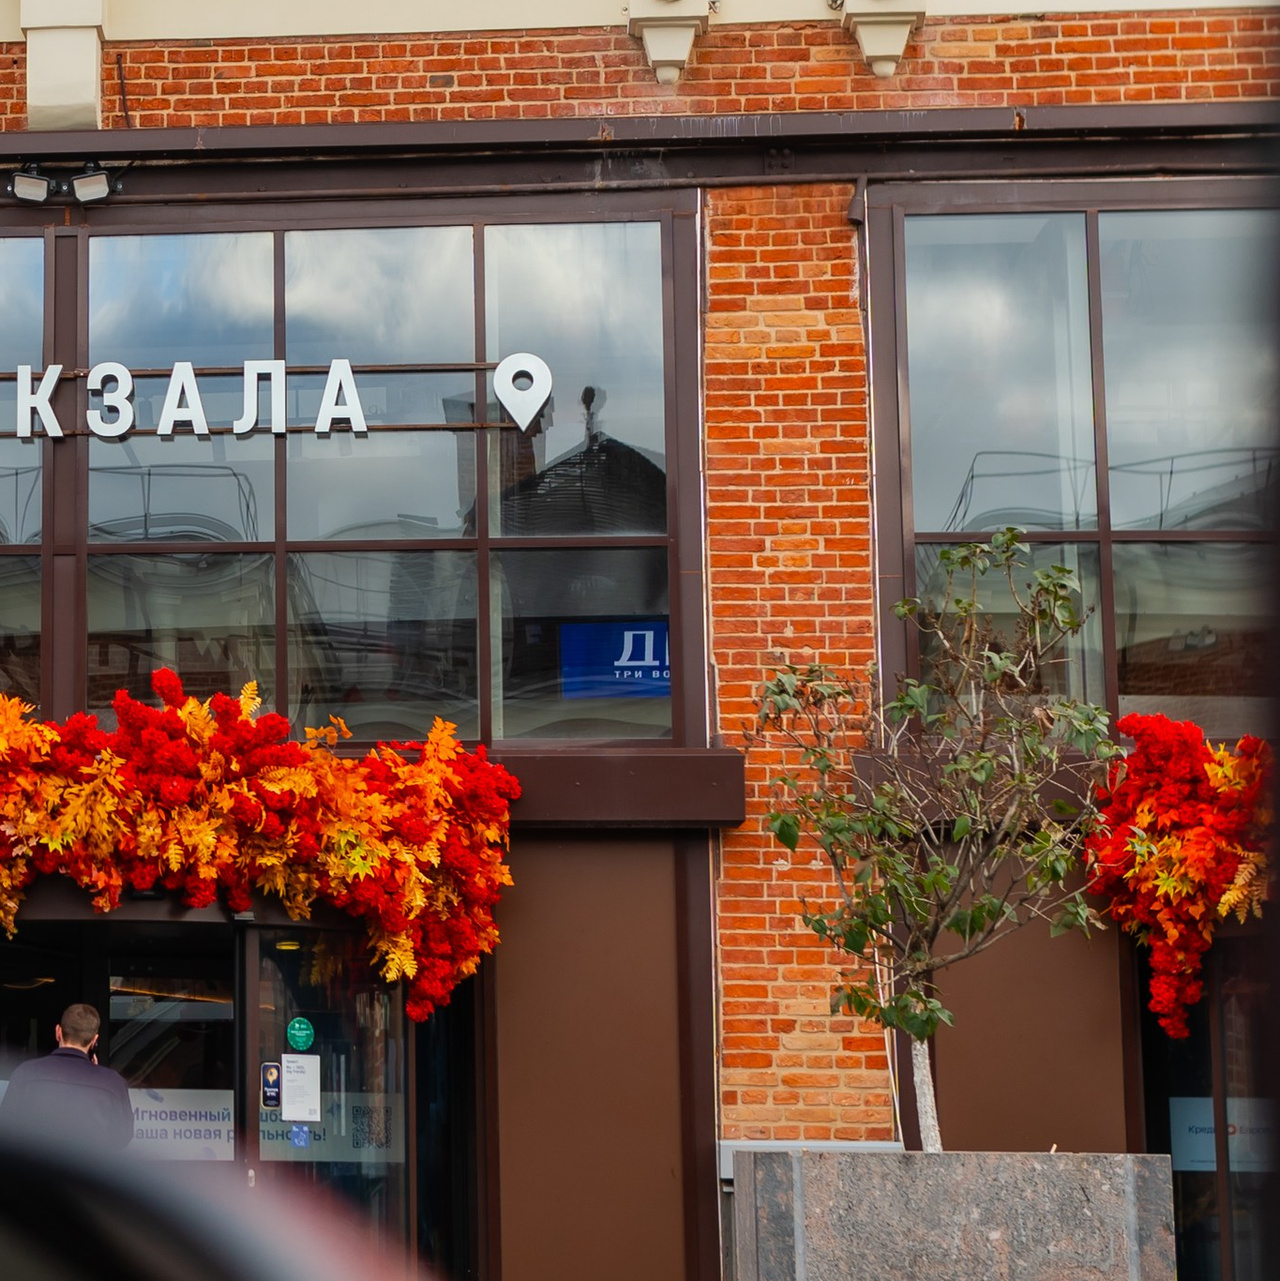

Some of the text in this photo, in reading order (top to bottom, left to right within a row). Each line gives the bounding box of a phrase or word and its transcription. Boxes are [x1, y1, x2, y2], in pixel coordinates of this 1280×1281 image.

[614, 630, 669, 667] Д
[614, 670, 643, 679] ТРИ
[135, 1128, 168, 1140] аша
[173, 1128, 222, 1140] новая
